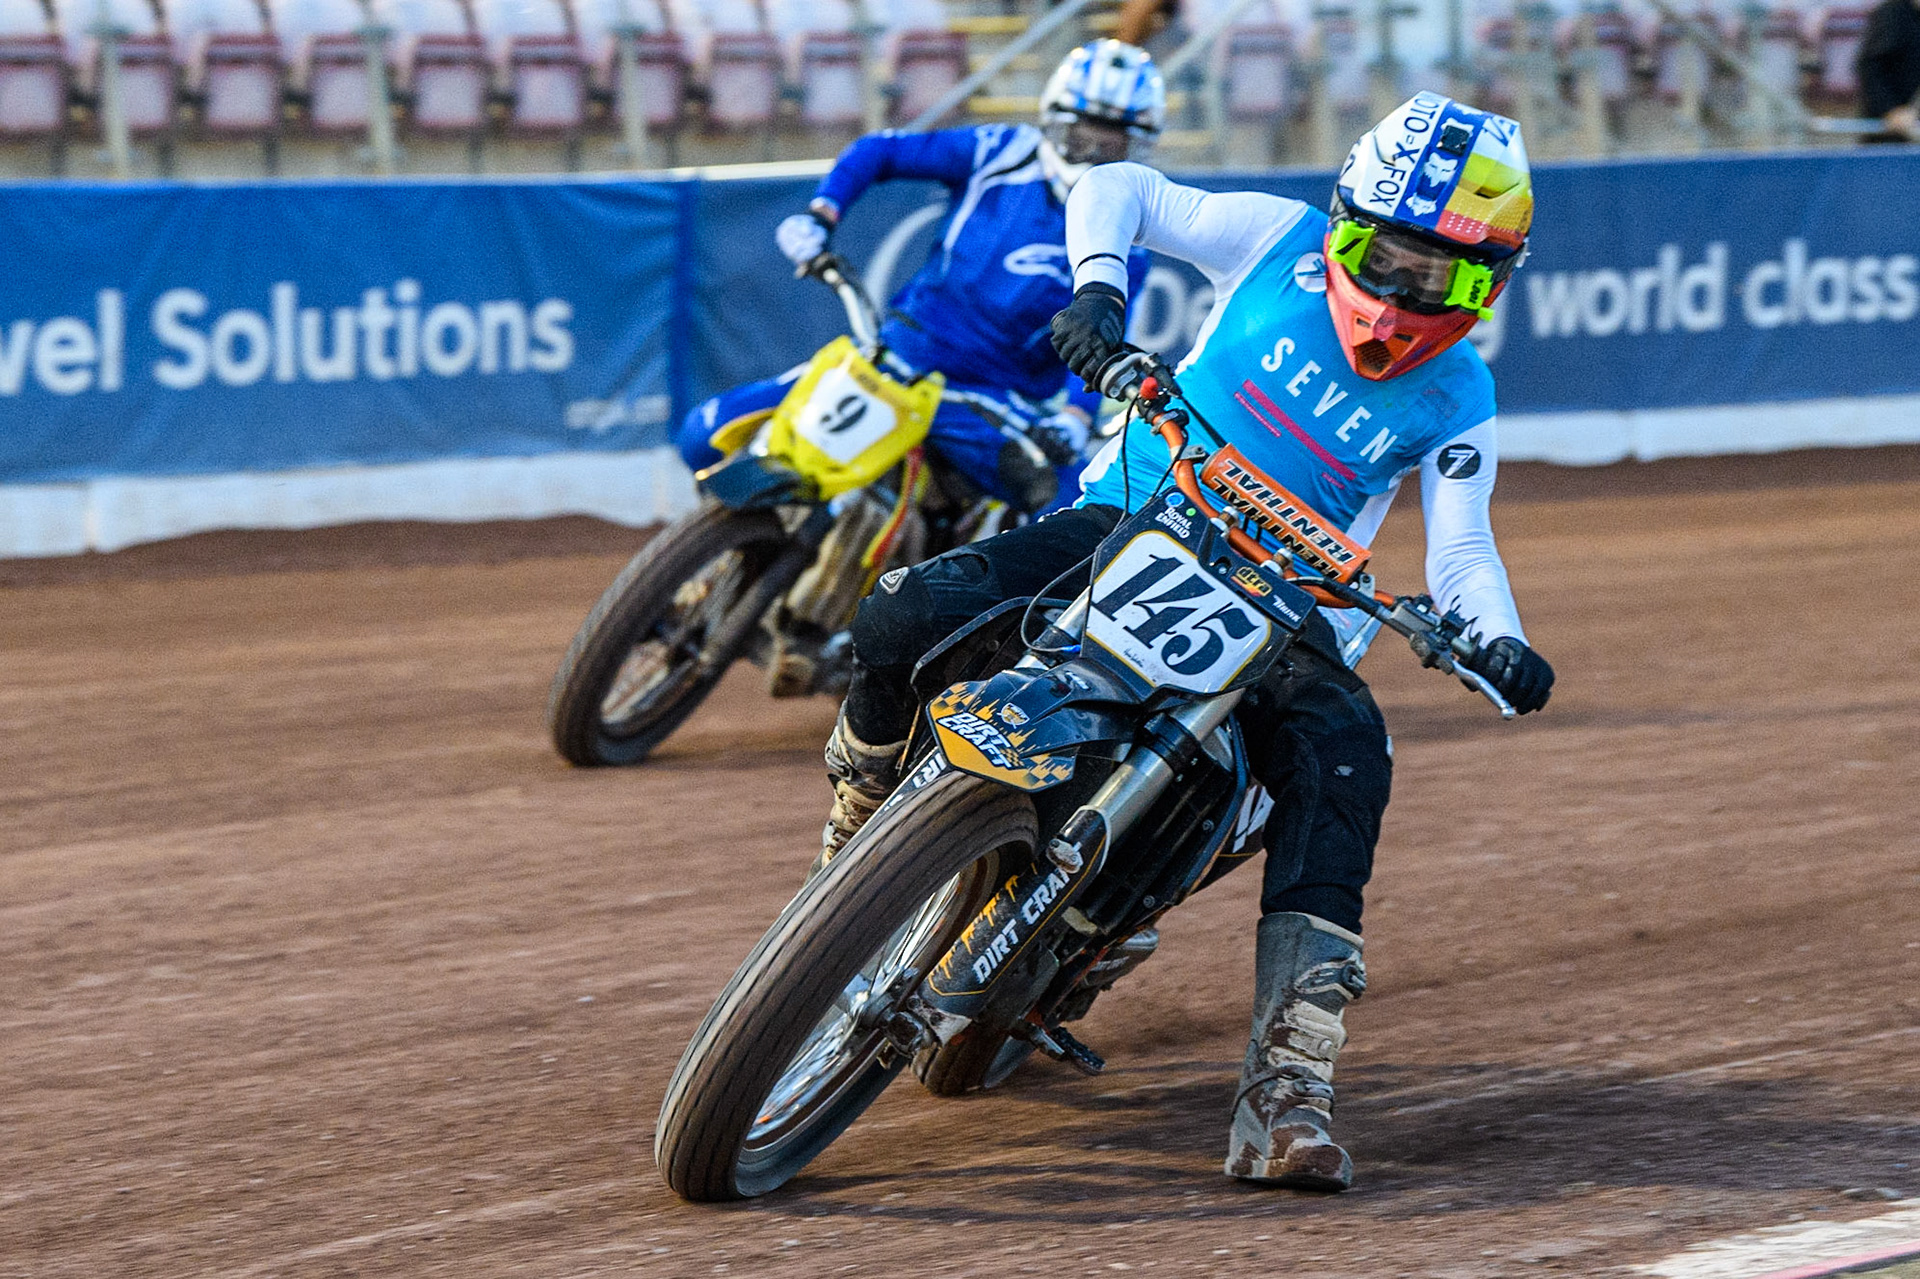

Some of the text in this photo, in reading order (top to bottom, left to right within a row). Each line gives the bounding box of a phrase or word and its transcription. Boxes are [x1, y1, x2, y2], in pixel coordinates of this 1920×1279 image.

[1369, 166, 1406, 208] FOX
[1526, 241, 1729, 338] world
[1743, 236, 1919, 328] class
[0, 279, 573, 396] vel Solutions
[820, 395, 868, 434] 9
[1261, 337, 1398, 464] SEVEN
[1155, 512, 1190, 539] ENFIELD
[1165, 507, 1192, 529] ROYAL
[1223, 458, 1357, 565] RENTHAL
[1090, 553, 1261, 676] 145
[938, 717, 1012, 768] CRAFT
[952, 712, 1011, 748] DIRT
[972, 919, 1019, 984] DIRT
